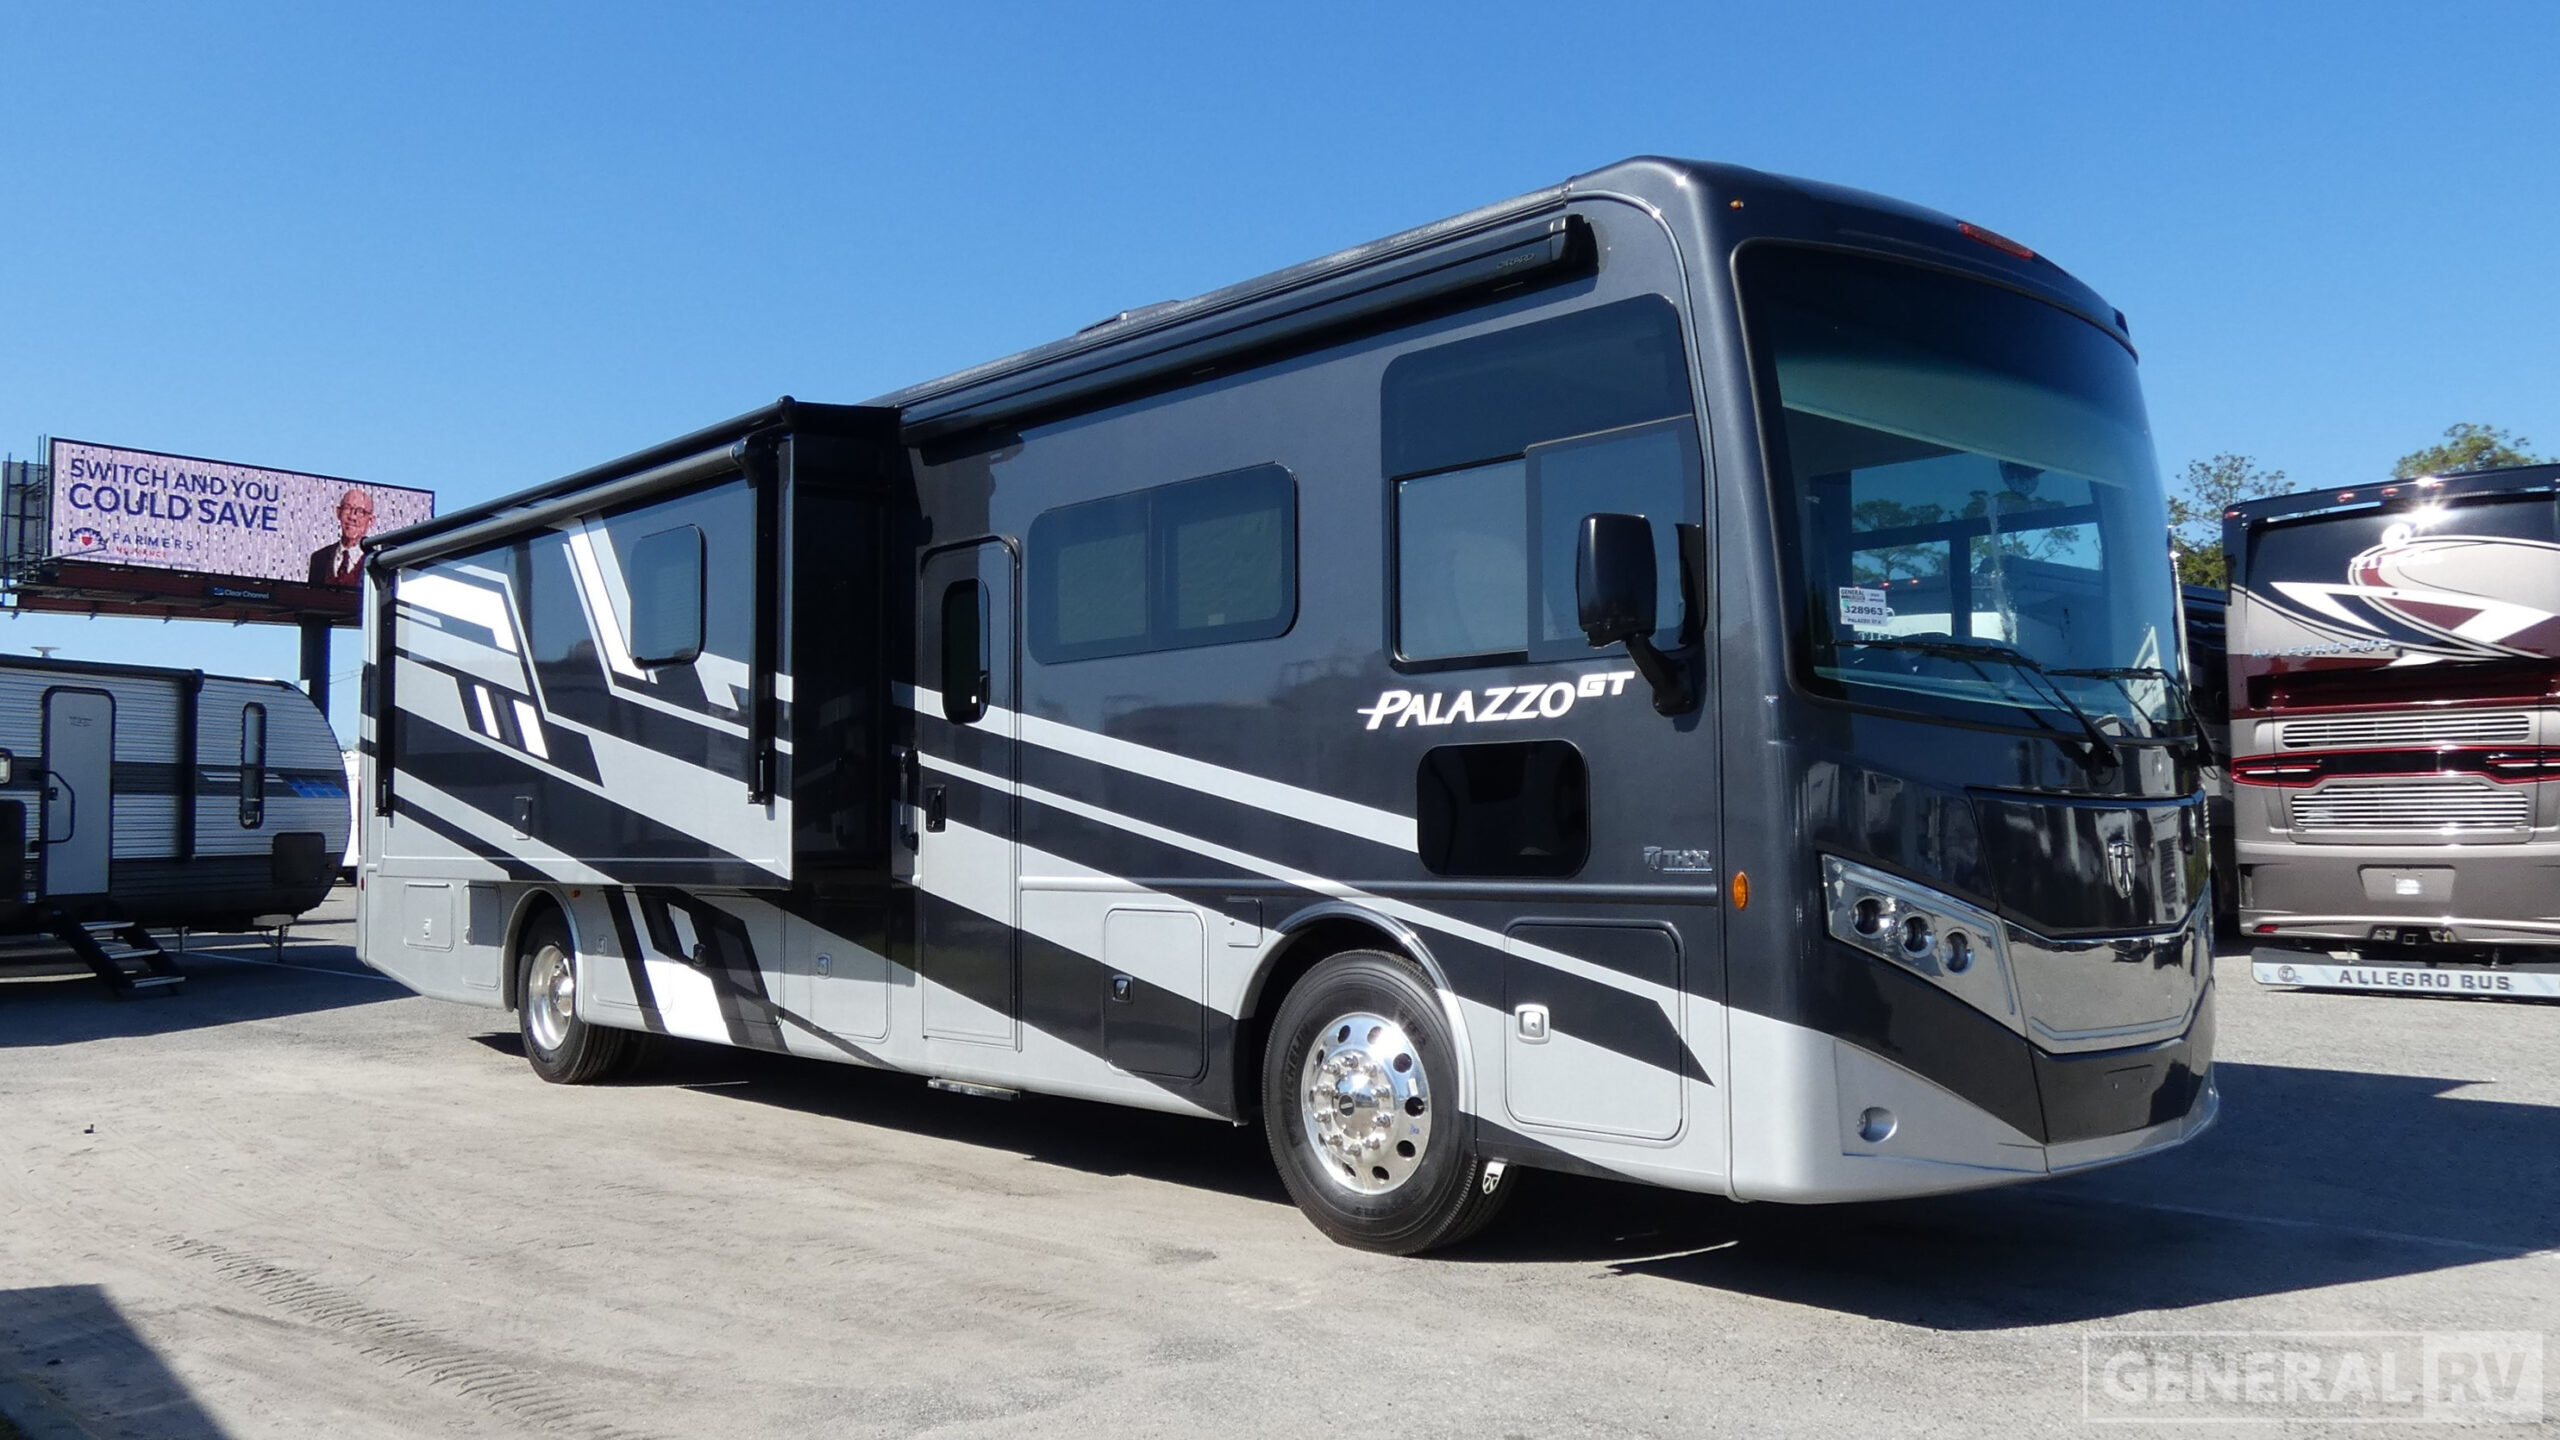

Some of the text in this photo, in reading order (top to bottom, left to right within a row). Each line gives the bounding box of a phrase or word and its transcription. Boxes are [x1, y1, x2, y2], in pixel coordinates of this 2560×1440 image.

[70, 458, 279, 502] SWITCH AND YOU
[69, 482, 279, 532] COULD SAVE
[112, 531, 194, 551] FARMERS
[224, 589, 270, 600] Clear Channel
[1844, 605, 1883, 616] 328963
[1357, 670, 1635, 730] PALAZZO GT
[2338, 969, 2511, 991] ALLEGRO BUS
